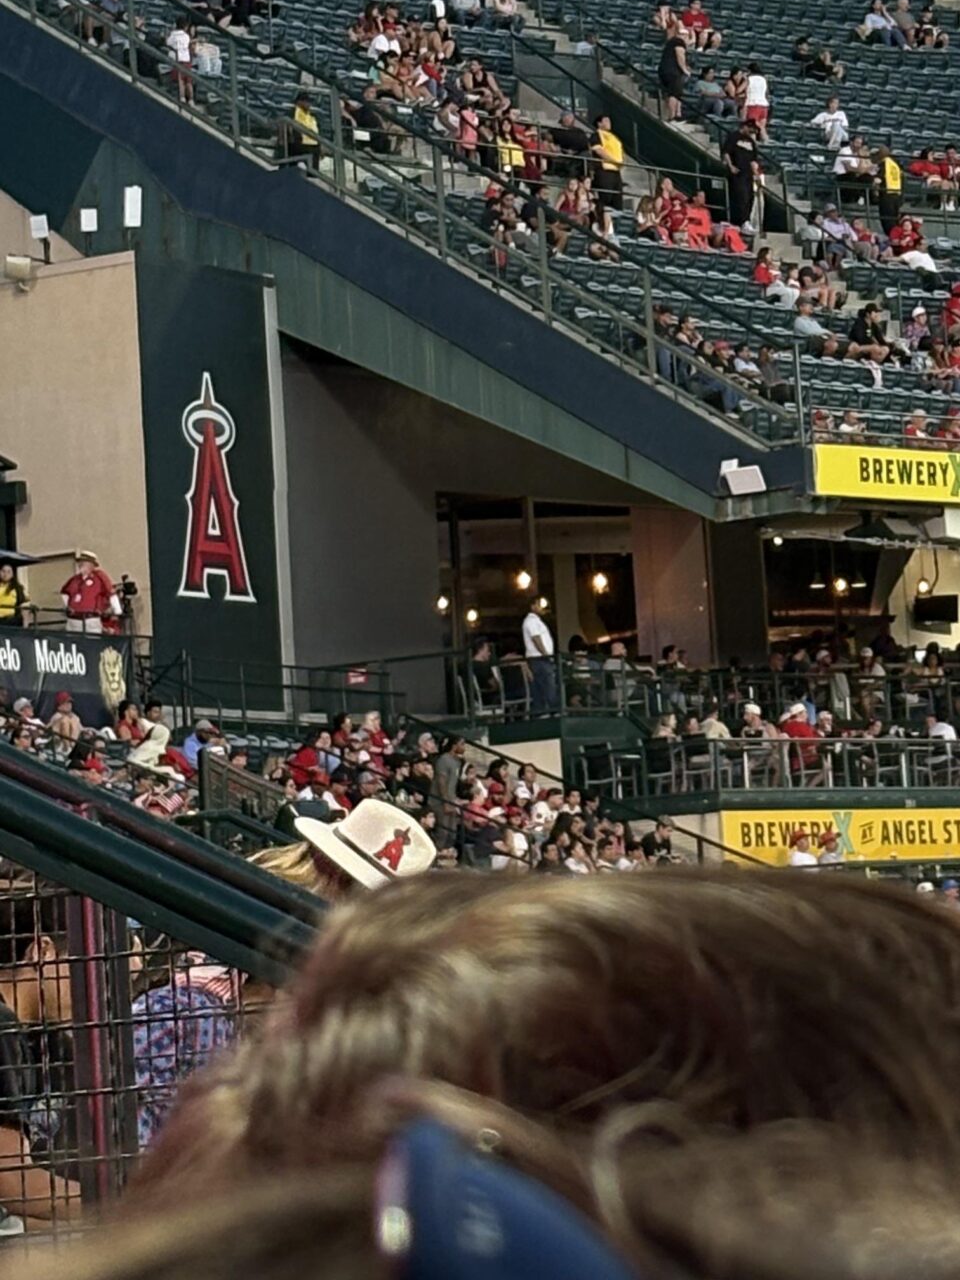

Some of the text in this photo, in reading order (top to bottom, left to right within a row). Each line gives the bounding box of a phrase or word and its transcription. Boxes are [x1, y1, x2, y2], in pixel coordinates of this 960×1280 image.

[34, 638, 86, 676] Modelo
[860, 824, 874, 842] AT
[880, 819, 938, 845] ANGEL
